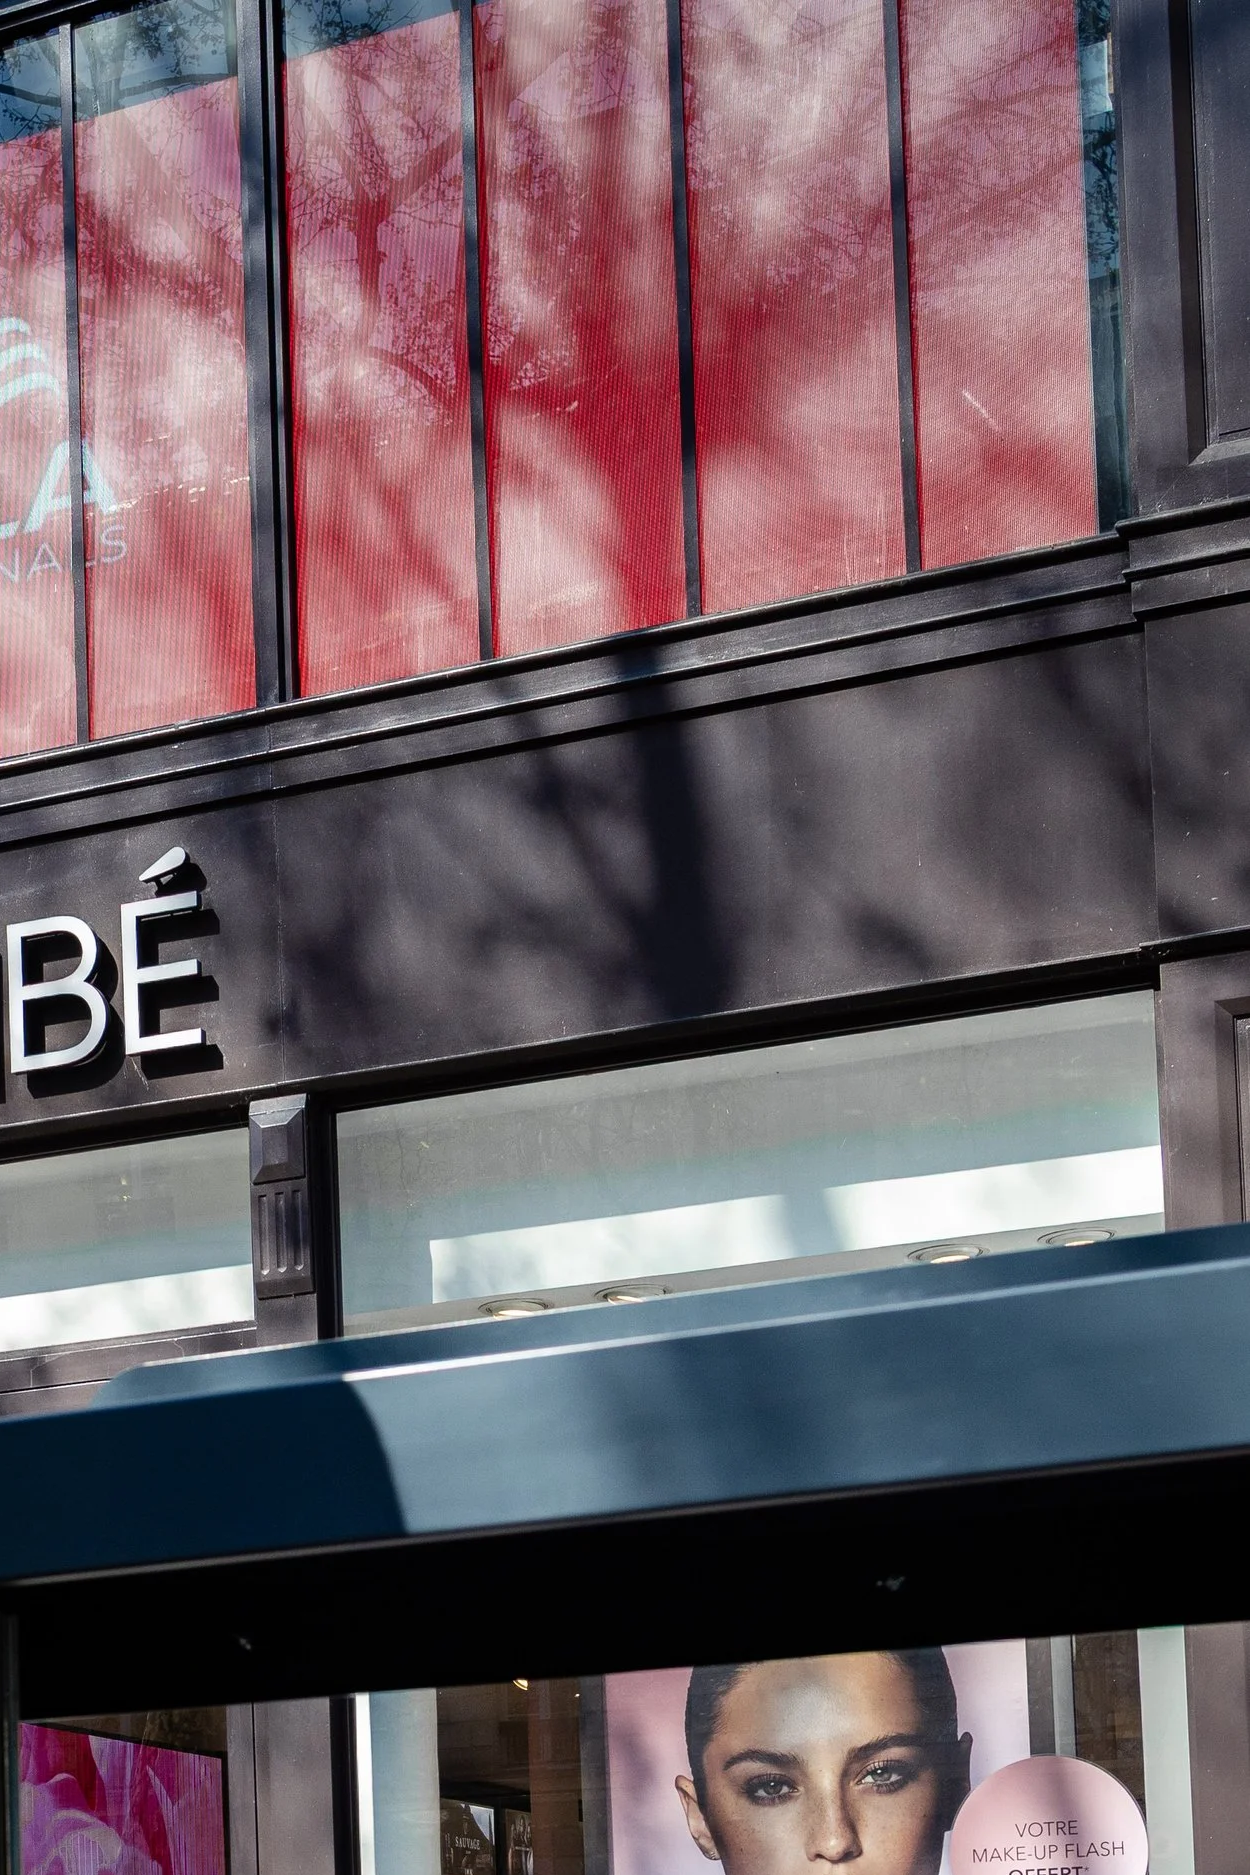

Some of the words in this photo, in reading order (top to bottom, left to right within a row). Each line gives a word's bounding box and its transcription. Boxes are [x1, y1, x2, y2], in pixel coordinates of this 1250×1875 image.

[1015, 1820, 1079, 1838] VOTRE
[455, 1836, 481, 1851] SAUVAGE
[972, 1844, 1058, 1863] MAKE-UP
[1065, 1841, 1125, 1859] FLASH
